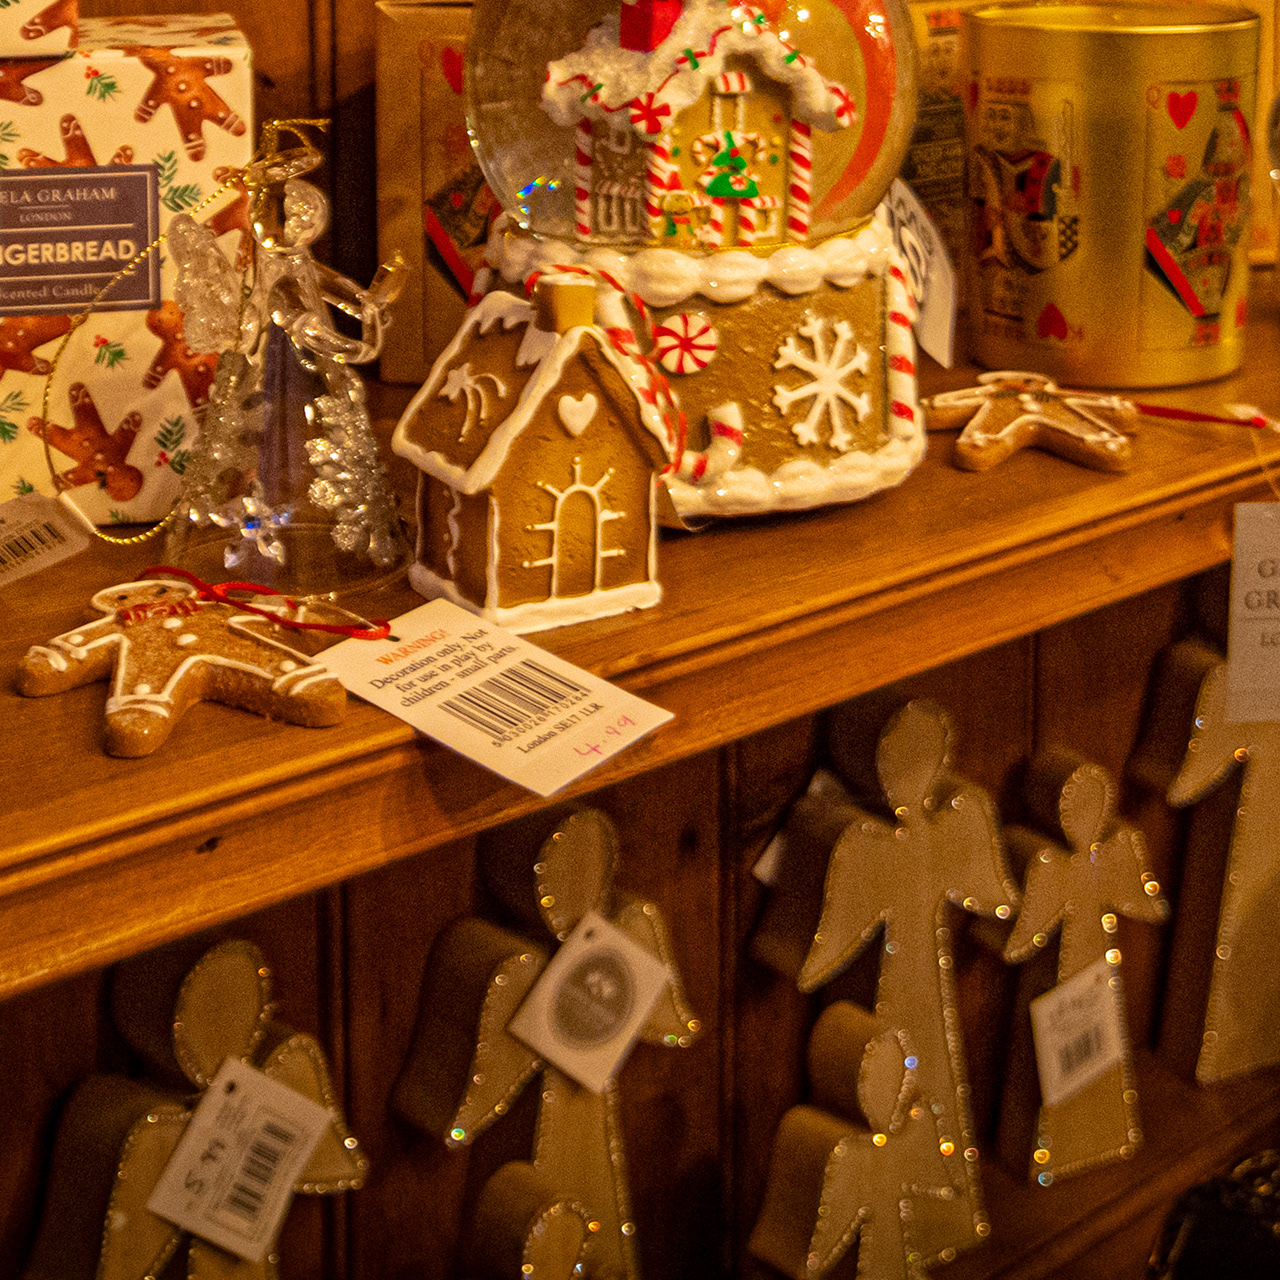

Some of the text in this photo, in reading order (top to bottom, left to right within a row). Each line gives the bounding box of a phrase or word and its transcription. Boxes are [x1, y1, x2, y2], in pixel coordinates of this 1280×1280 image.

[36, 186, 117, 202] GRAHAM
[19, 211, 72, 223] LONDON
[52, 283, 101, 298] Candle
[368, 628, 489, 691] Decoration only. Not
[375, 628, 449, 666] WARNING!
[394, 640, 494, 694] for use in play by
[399, 678, 451, 709] children
[454, 658, 490, 679] small
[485, 644, 520, 666] parts.
[515, 729, 559, 754] London
[553, 714, 583, 733] SE17
